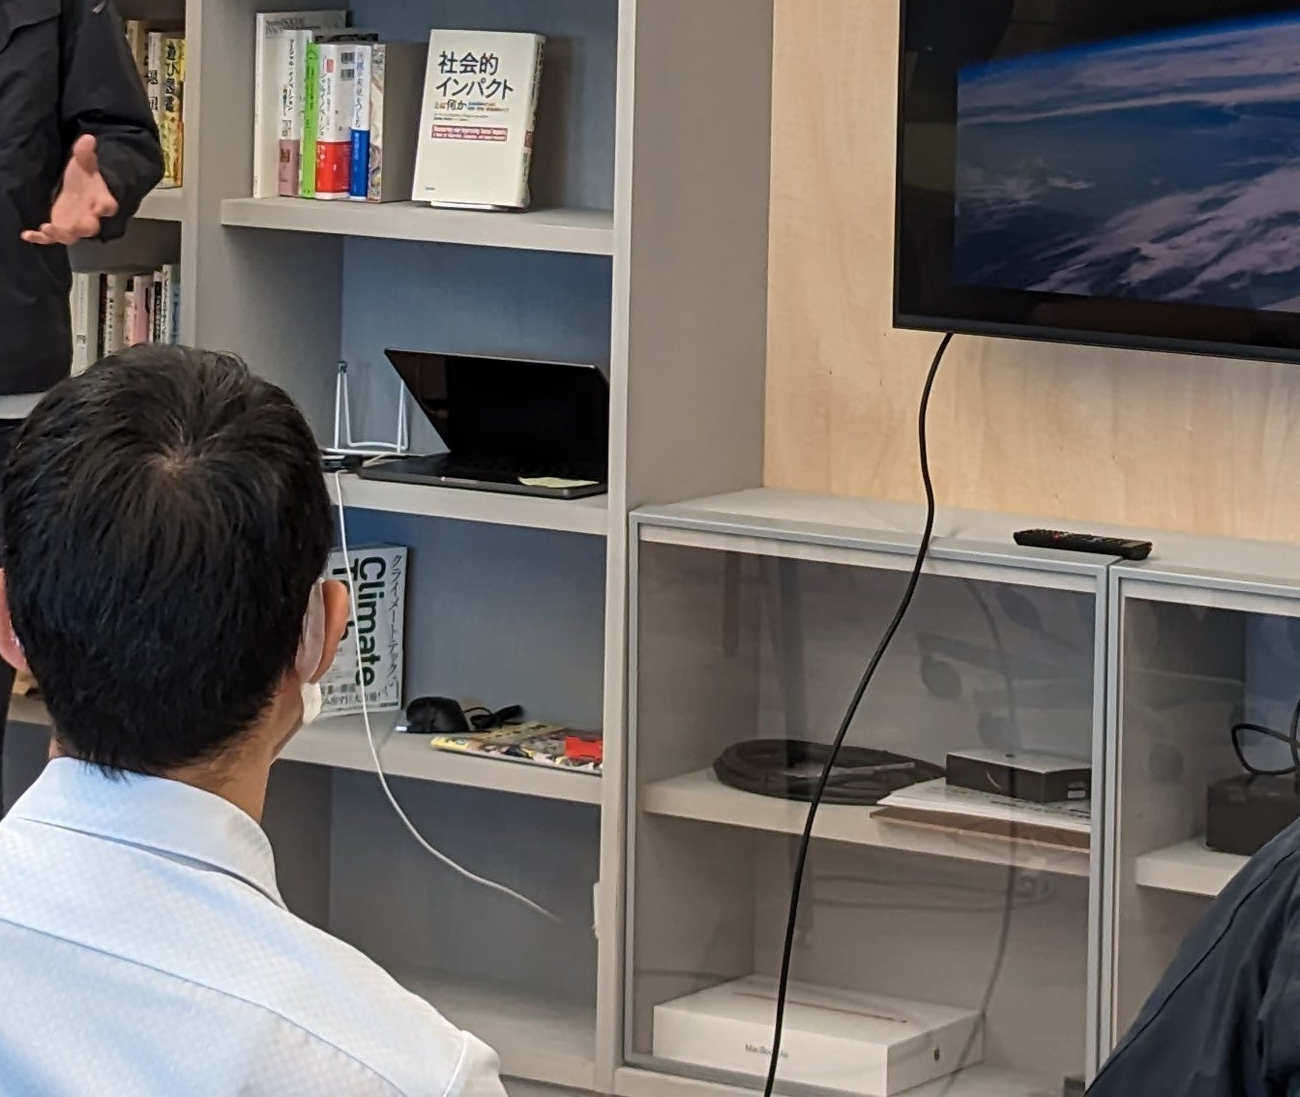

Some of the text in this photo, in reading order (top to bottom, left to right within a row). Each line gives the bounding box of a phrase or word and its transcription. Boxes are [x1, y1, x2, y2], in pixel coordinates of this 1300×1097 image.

[437, 50, 499, 76] 社会的
[435, 76, 514, 101] インパクト
[355, 556, 387, 687] Climate
